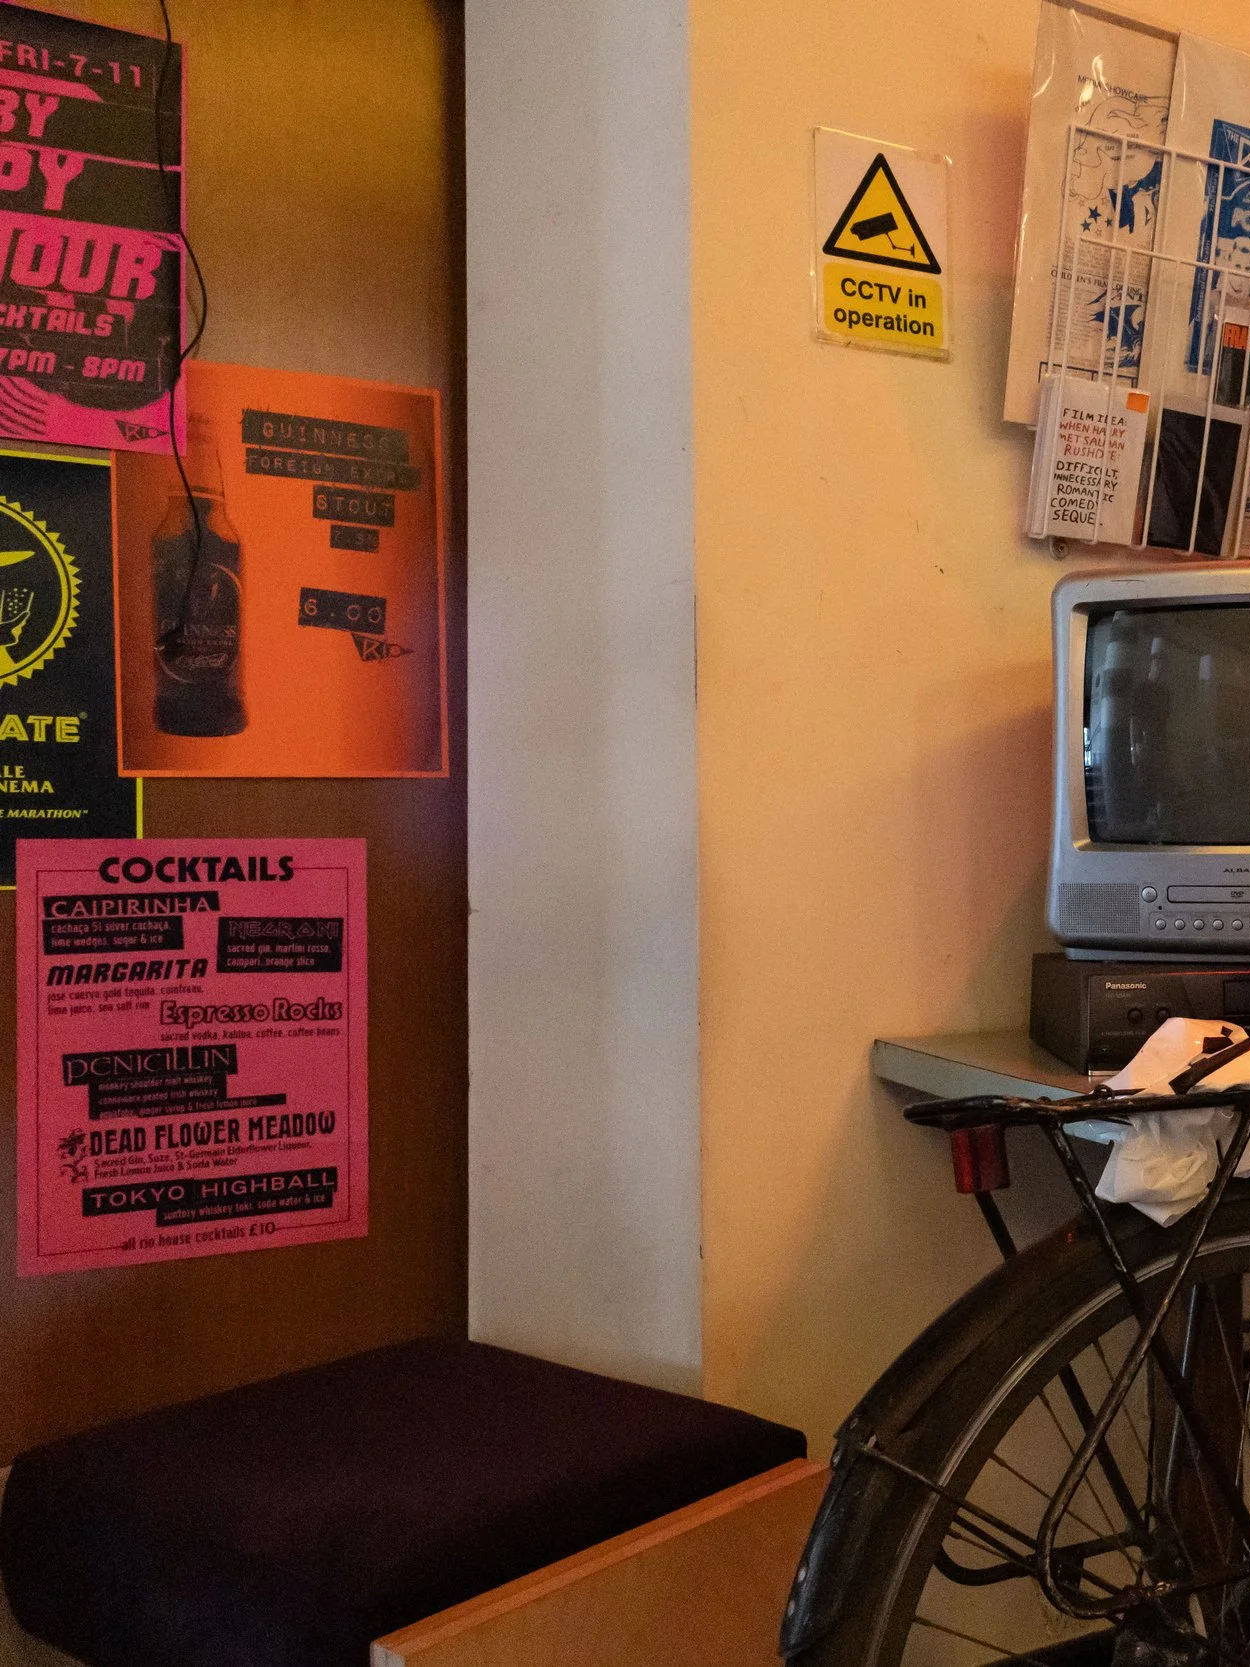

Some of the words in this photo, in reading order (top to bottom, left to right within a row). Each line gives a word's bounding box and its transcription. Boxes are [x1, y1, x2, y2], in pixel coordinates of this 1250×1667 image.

[0, 228, 162, 300] OUR
[840, 277, 902, 304] CCTV
[907, 288, 927, 309] in
[0, 305, 113, 337] KTAILS
[833, 307, 935, 337] operation
[82, 356, 146, 382] 8PM
[1062, 408, 1095, 422] FILM
[1060, 421, 1090, 434] WHEN
[1092, 423, 1126, 438] HARY
[316, 494, 391, 519] STOUT
[1057, 483, 1115, 503] ROMANTIC
[1052, 509, 1103, 526] SEQUE.
[0, 765, 26, 779] LE
[99, 856, 294, 884] COCKTAILS
[51, 896, 212, 918] CAIPIRINHA
[47, 958, 209, 987] MARGARITA
[1105, 981, 1147, 990] Panasonic
[160, 1000, 270, 1030] Espresso
[273, 997, 343, 1021] Rocks
[90, 1126, 147, 1157] DEAD
[154, 1117, 241, 1151] FLOWER
[248, 1110, 336, 1142] MEADOW
[90, 1185, 186, 1209] TOKYO
[201, 1172, 335, 1198] HIGHBALL
